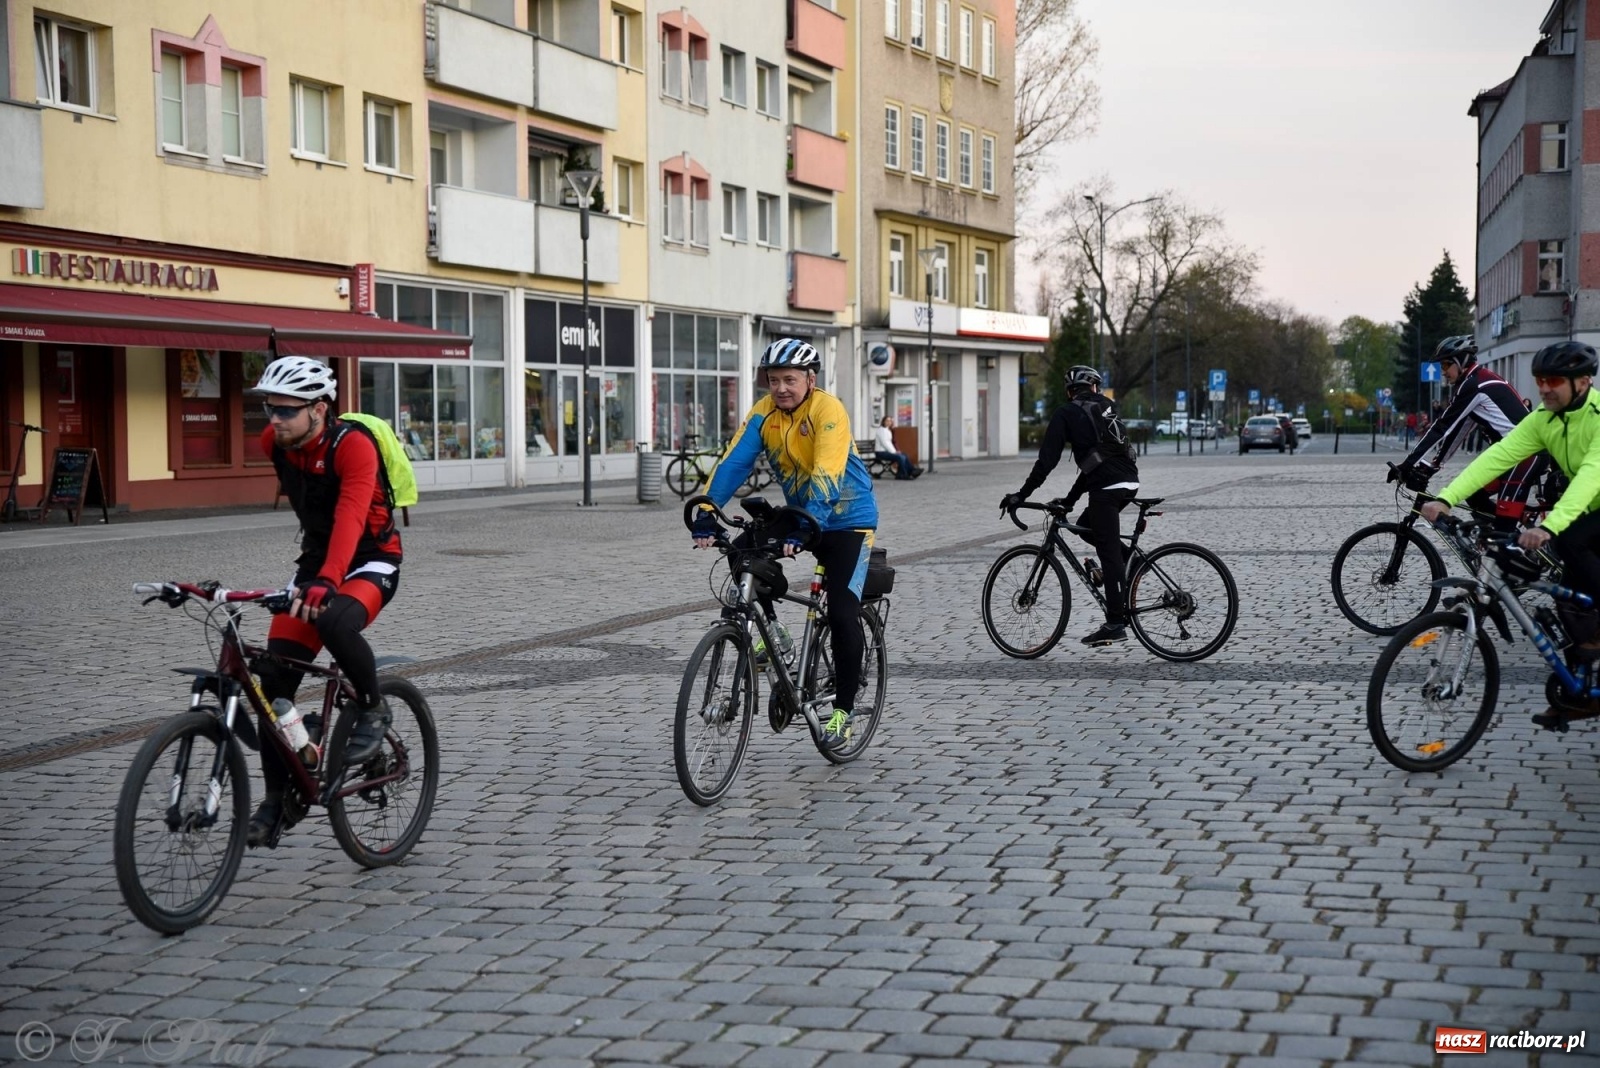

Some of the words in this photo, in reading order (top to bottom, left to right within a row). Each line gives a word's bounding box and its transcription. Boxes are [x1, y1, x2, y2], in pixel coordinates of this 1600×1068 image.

[43, 251, 219, 291] RESTAURACJA
[357, 267, 368, 308] ŻYWIEC
[5, 326, 23, 335] SMAKI
[24, 326, 46, 337] ŚWIATA
[1212, 372, 1224, 386] P
